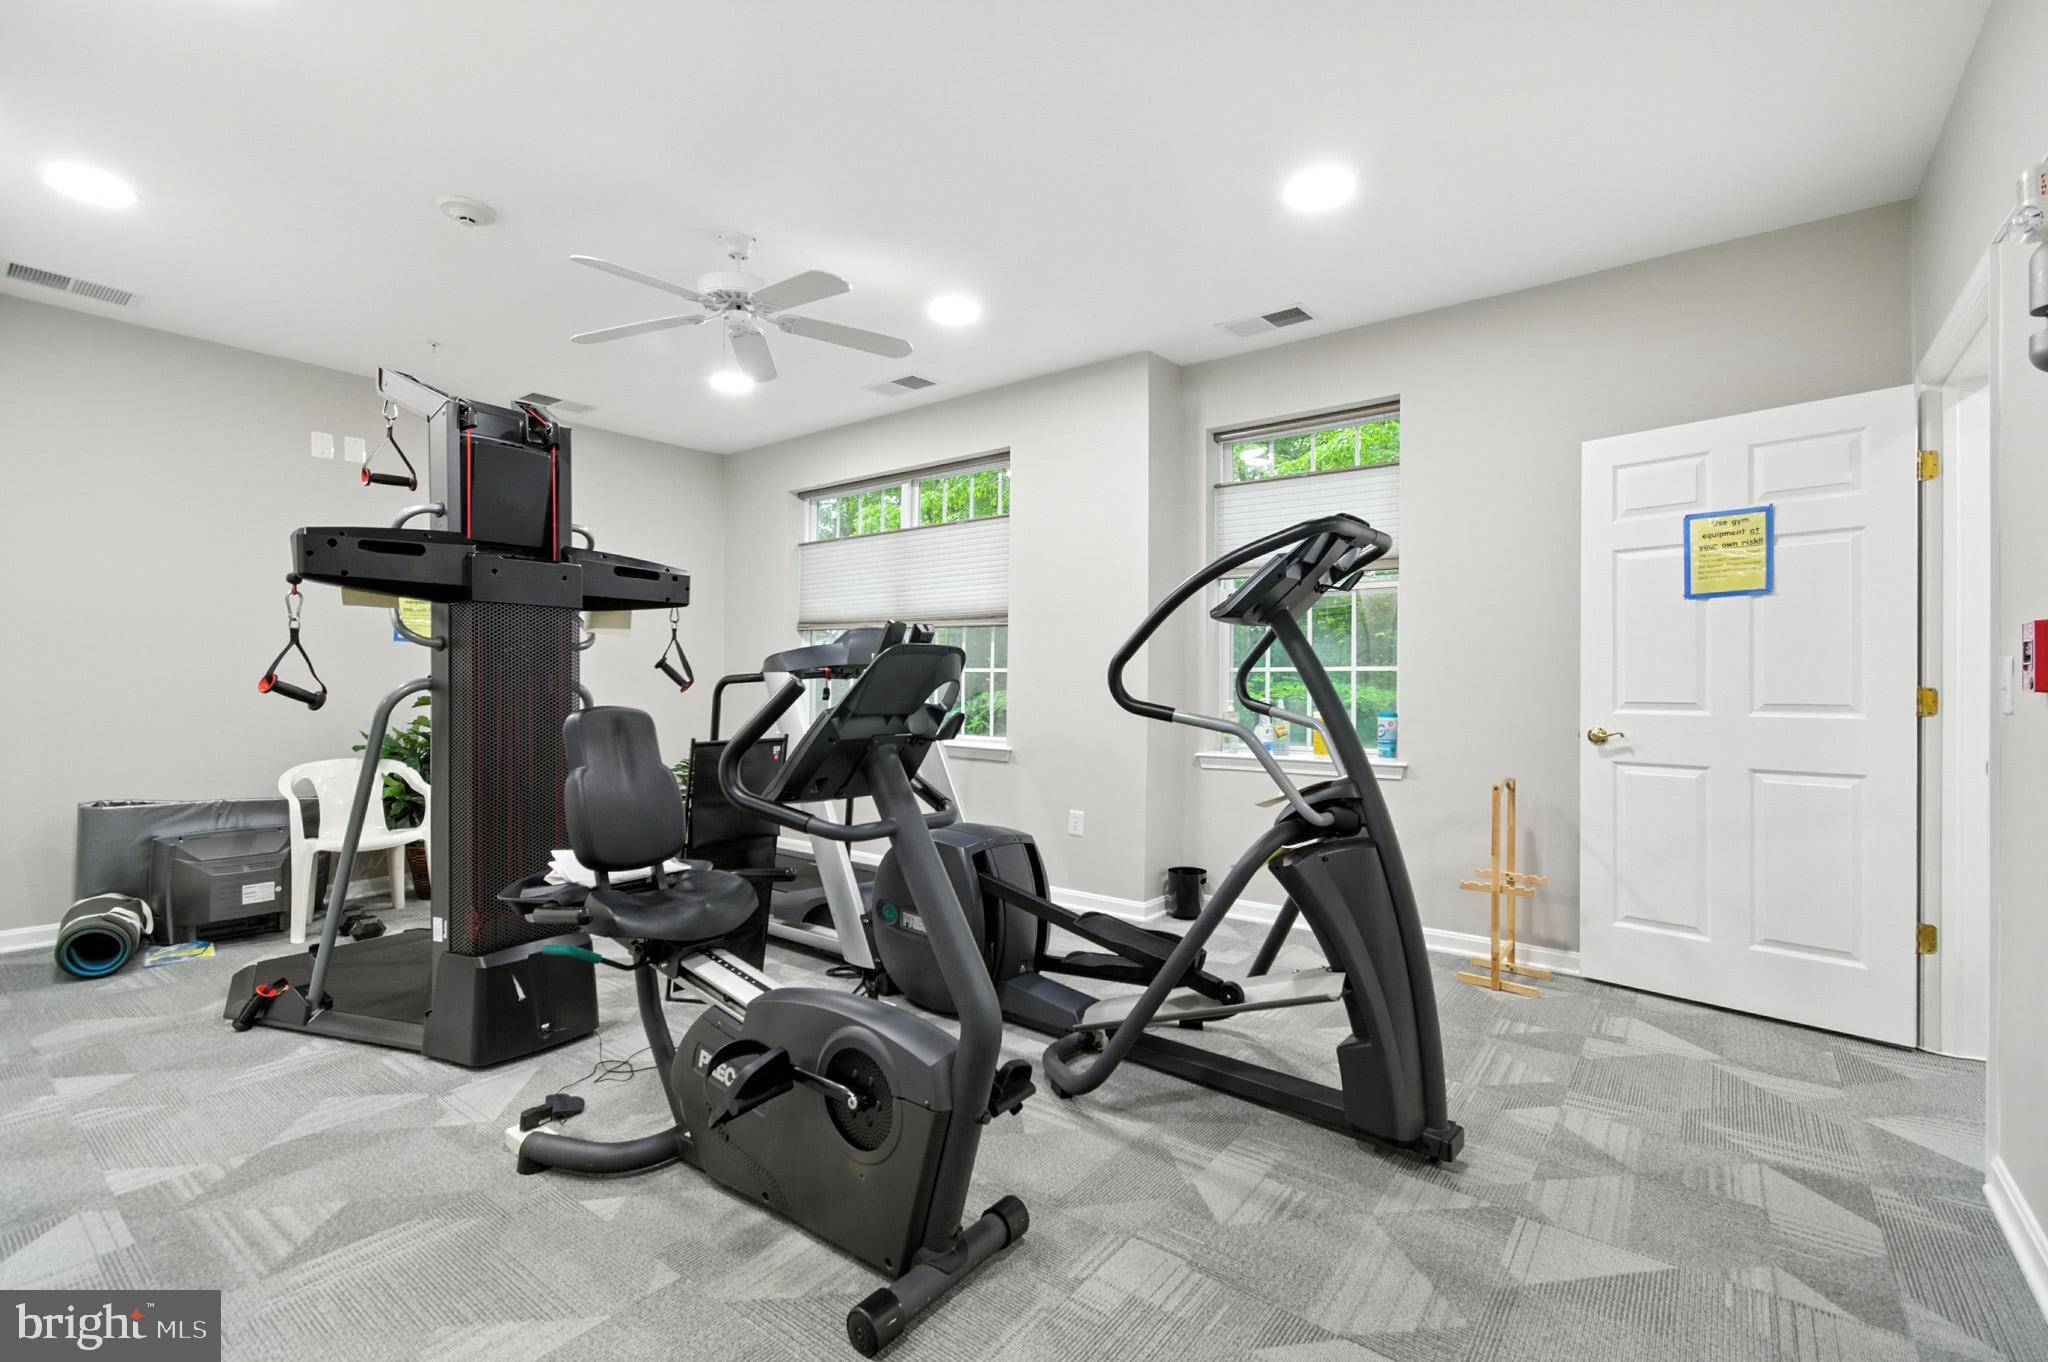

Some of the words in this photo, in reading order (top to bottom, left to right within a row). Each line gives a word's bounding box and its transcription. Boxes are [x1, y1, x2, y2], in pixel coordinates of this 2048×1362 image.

[1711, 519, 1728, 527] Use
[1731, 518, 1749, 526] gym
[1702, 529, 1746, 539] equipment
